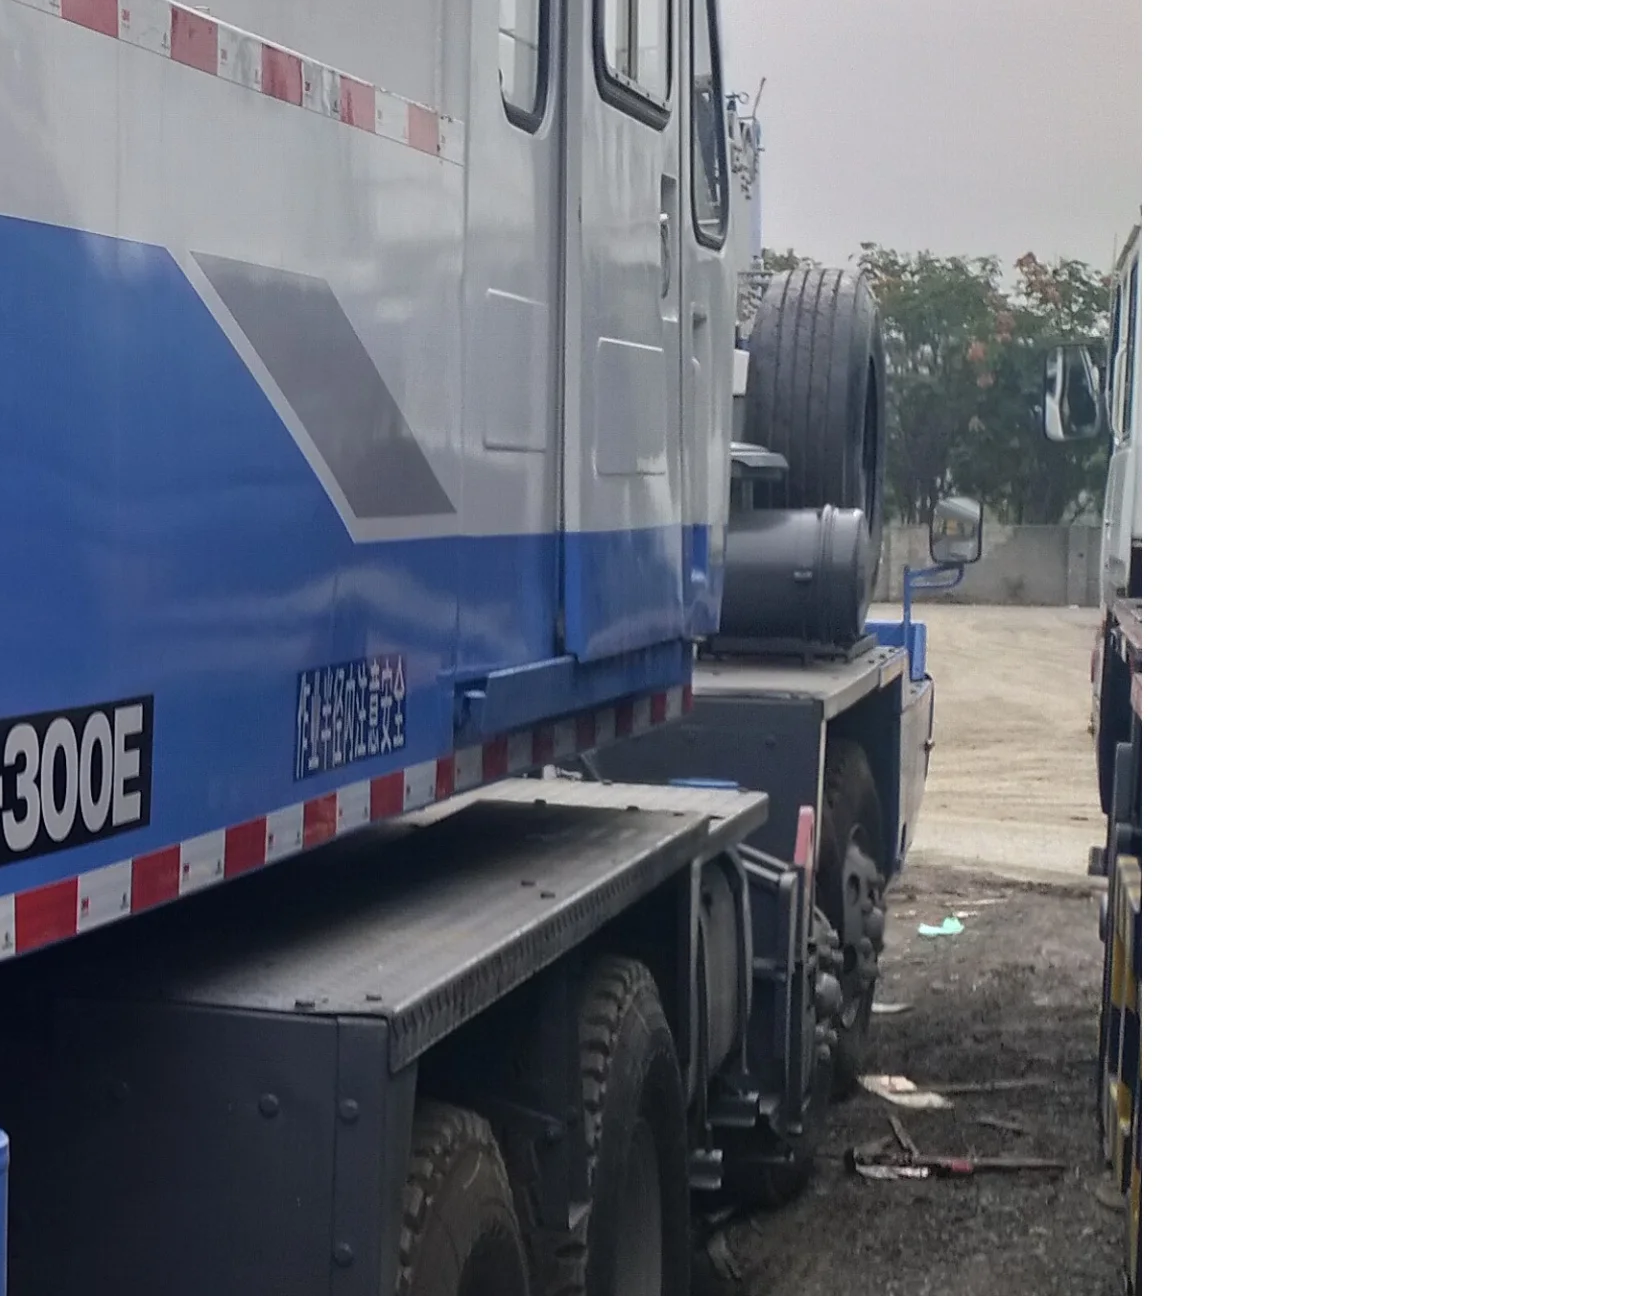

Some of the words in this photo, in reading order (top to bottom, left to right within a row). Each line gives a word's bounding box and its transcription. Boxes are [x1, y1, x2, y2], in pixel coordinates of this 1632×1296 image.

[295, 655, 404, 780] 作业半径内注意安全
